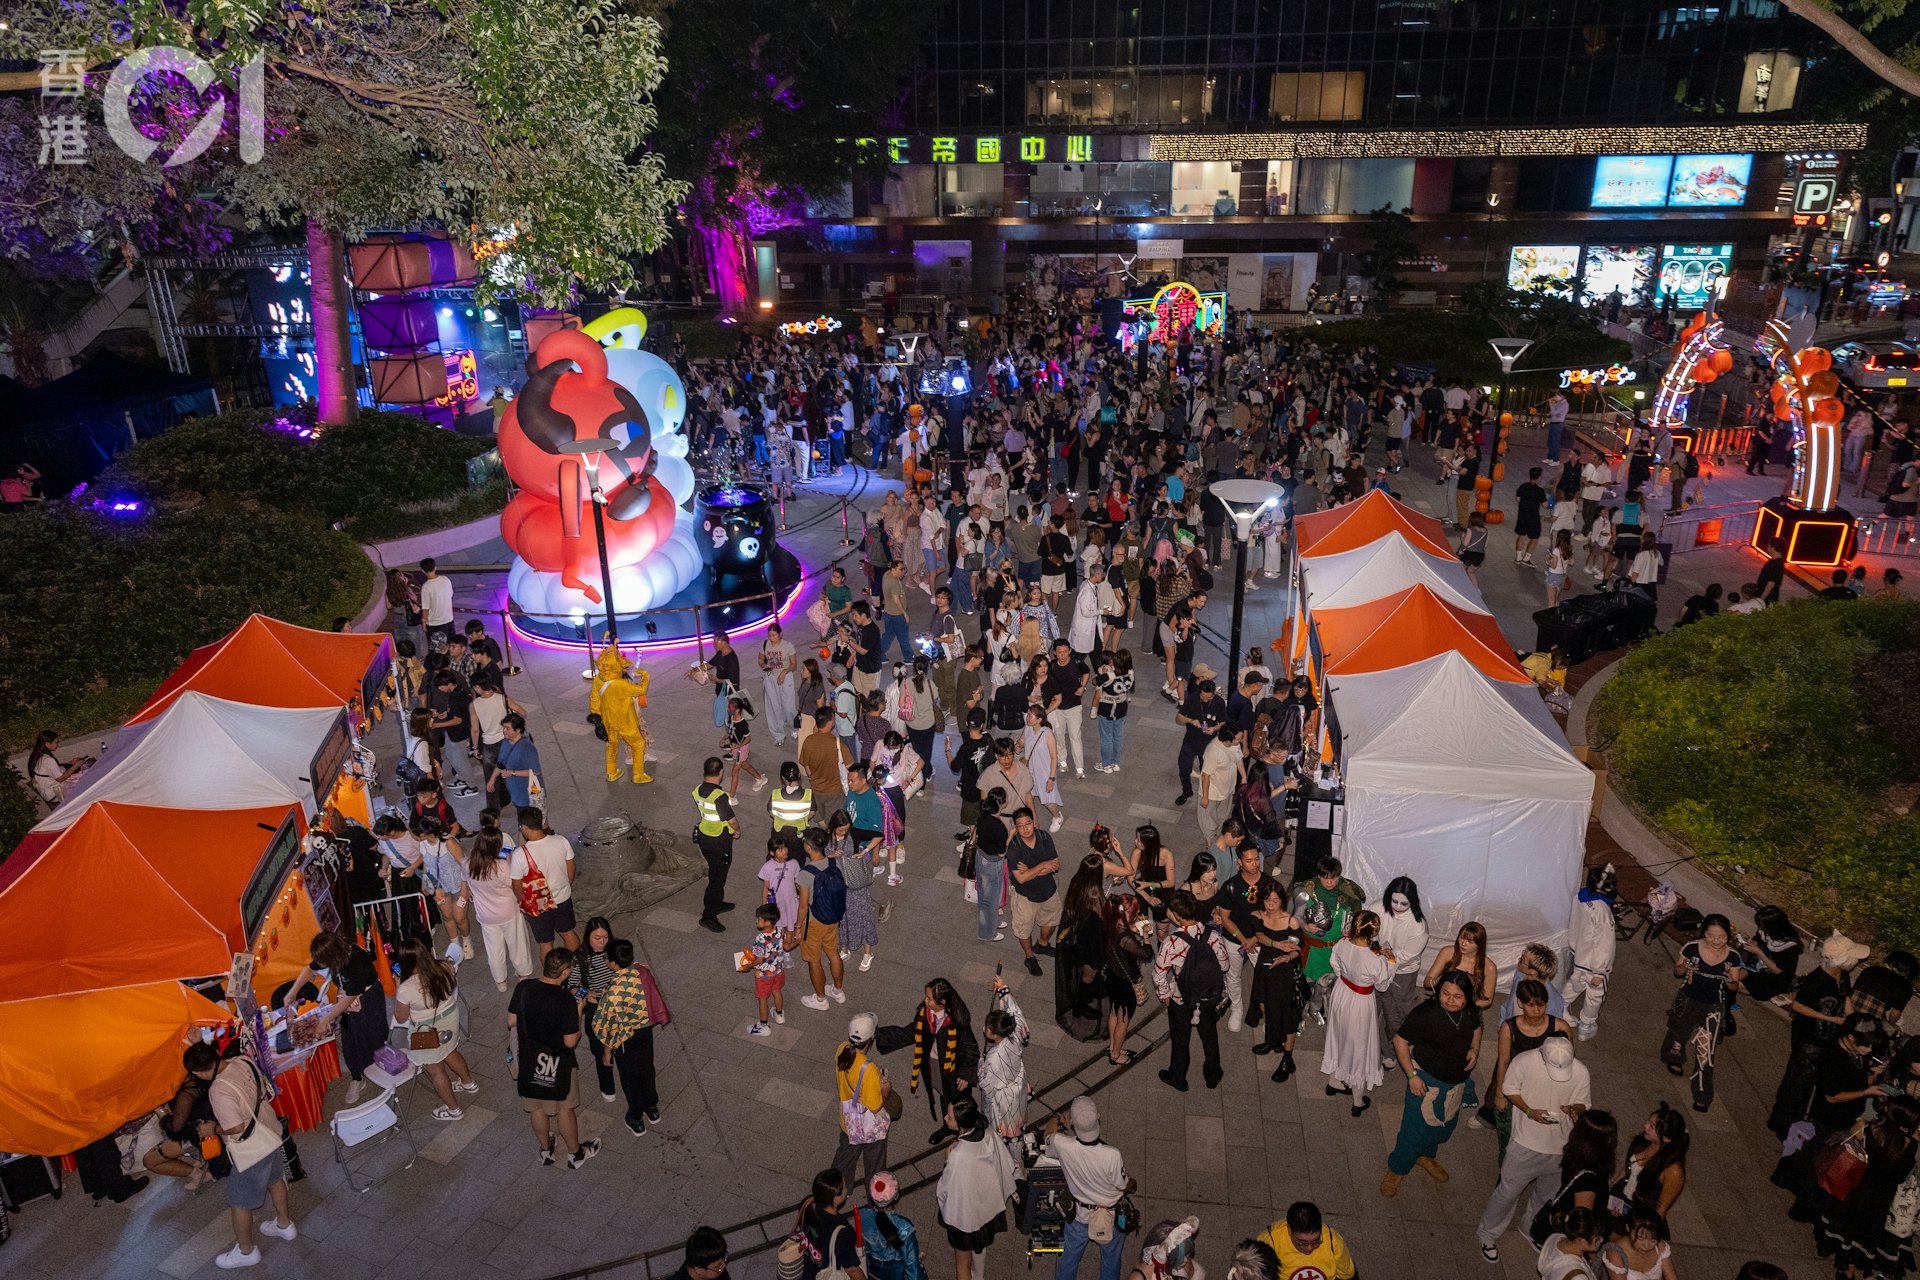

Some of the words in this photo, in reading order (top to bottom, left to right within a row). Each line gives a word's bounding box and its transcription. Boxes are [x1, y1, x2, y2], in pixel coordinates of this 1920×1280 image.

[932, 136, 1092, 163] 帝國中心
[1801, 184, 1829, 210] P
